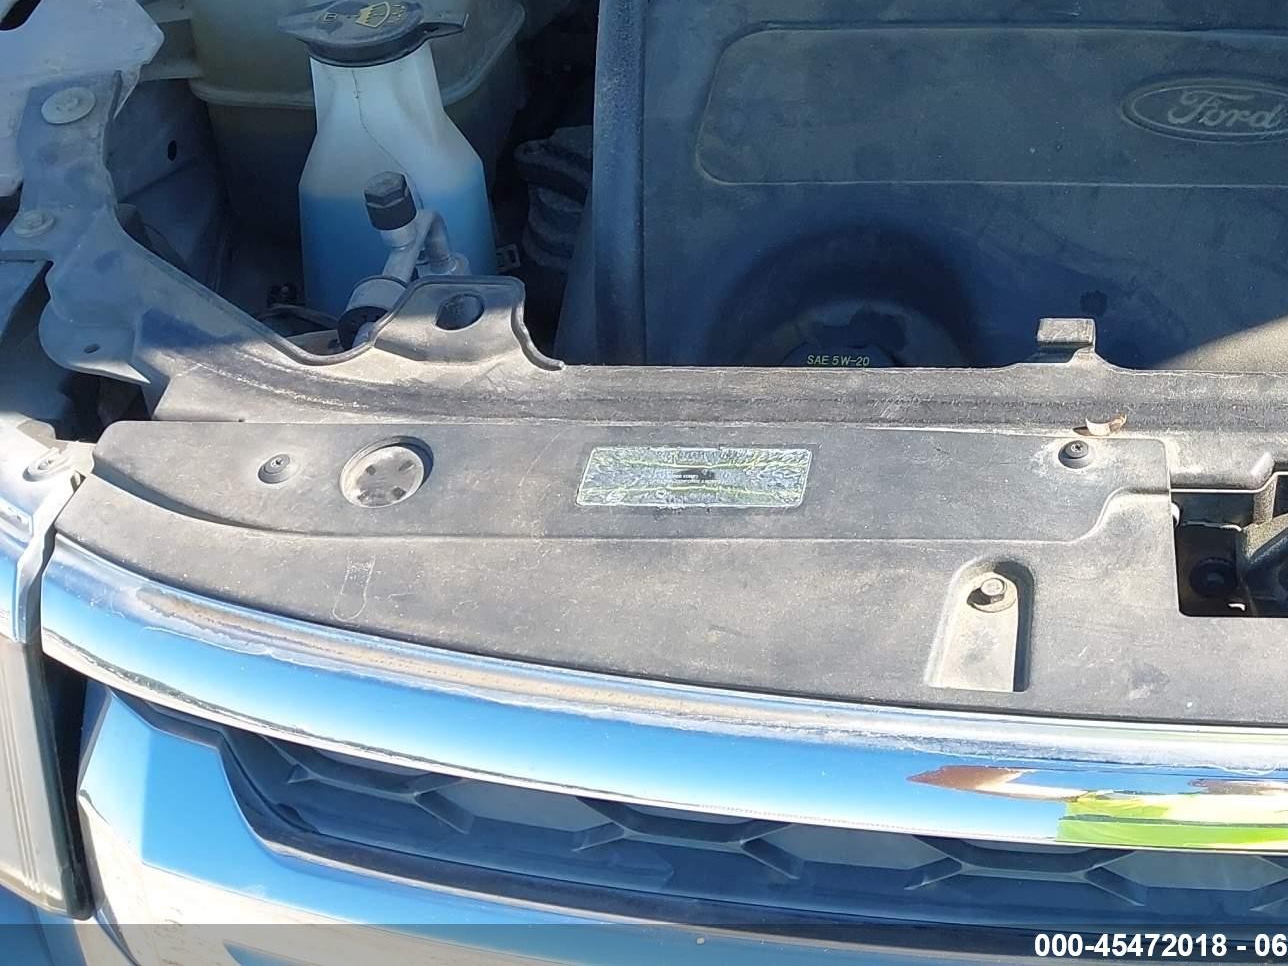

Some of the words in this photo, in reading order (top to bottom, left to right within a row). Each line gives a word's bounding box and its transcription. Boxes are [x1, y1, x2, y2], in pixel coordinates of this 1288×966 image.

[1167, 90, 1284, 128] Ford
[806, 354, 830, 365] SAE
[831, 355, 870, 366] 5W-20
